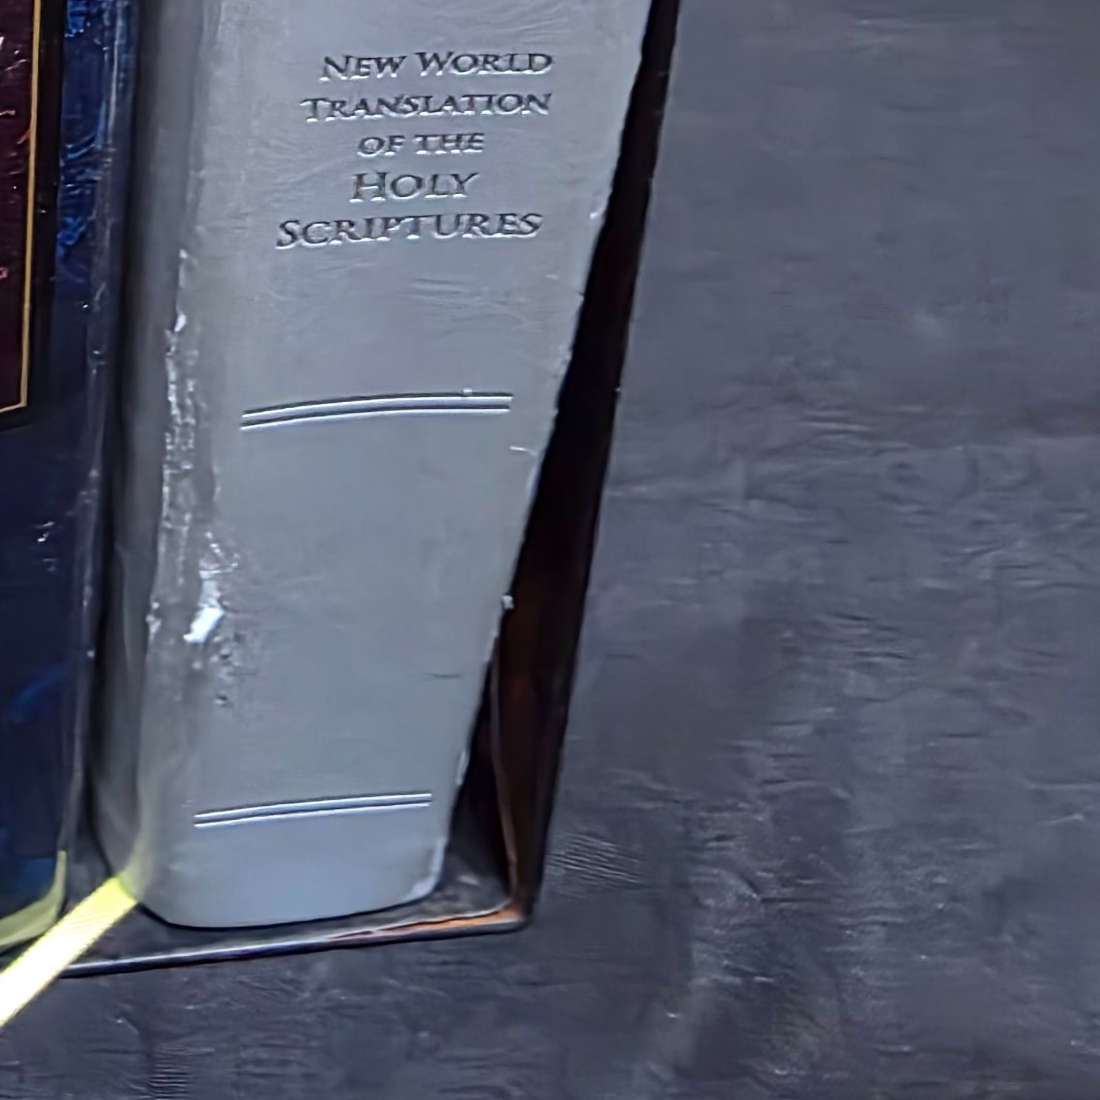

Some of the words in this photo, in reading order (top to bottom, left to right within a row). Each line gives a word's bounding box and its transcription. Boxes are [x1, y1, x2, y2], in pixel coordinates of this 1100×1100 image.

[318, 55, 407, 81] NEW
[415, 51, 553, 76] WORLD
[300, 93, 553, 122] TRANSLATION
[356, 135, 405, 157] OF
[415, 132, 486, 155] THE
[349, 171, 480, 202] HOLY
[274, 212, 545, 250] SCRIPTURES
